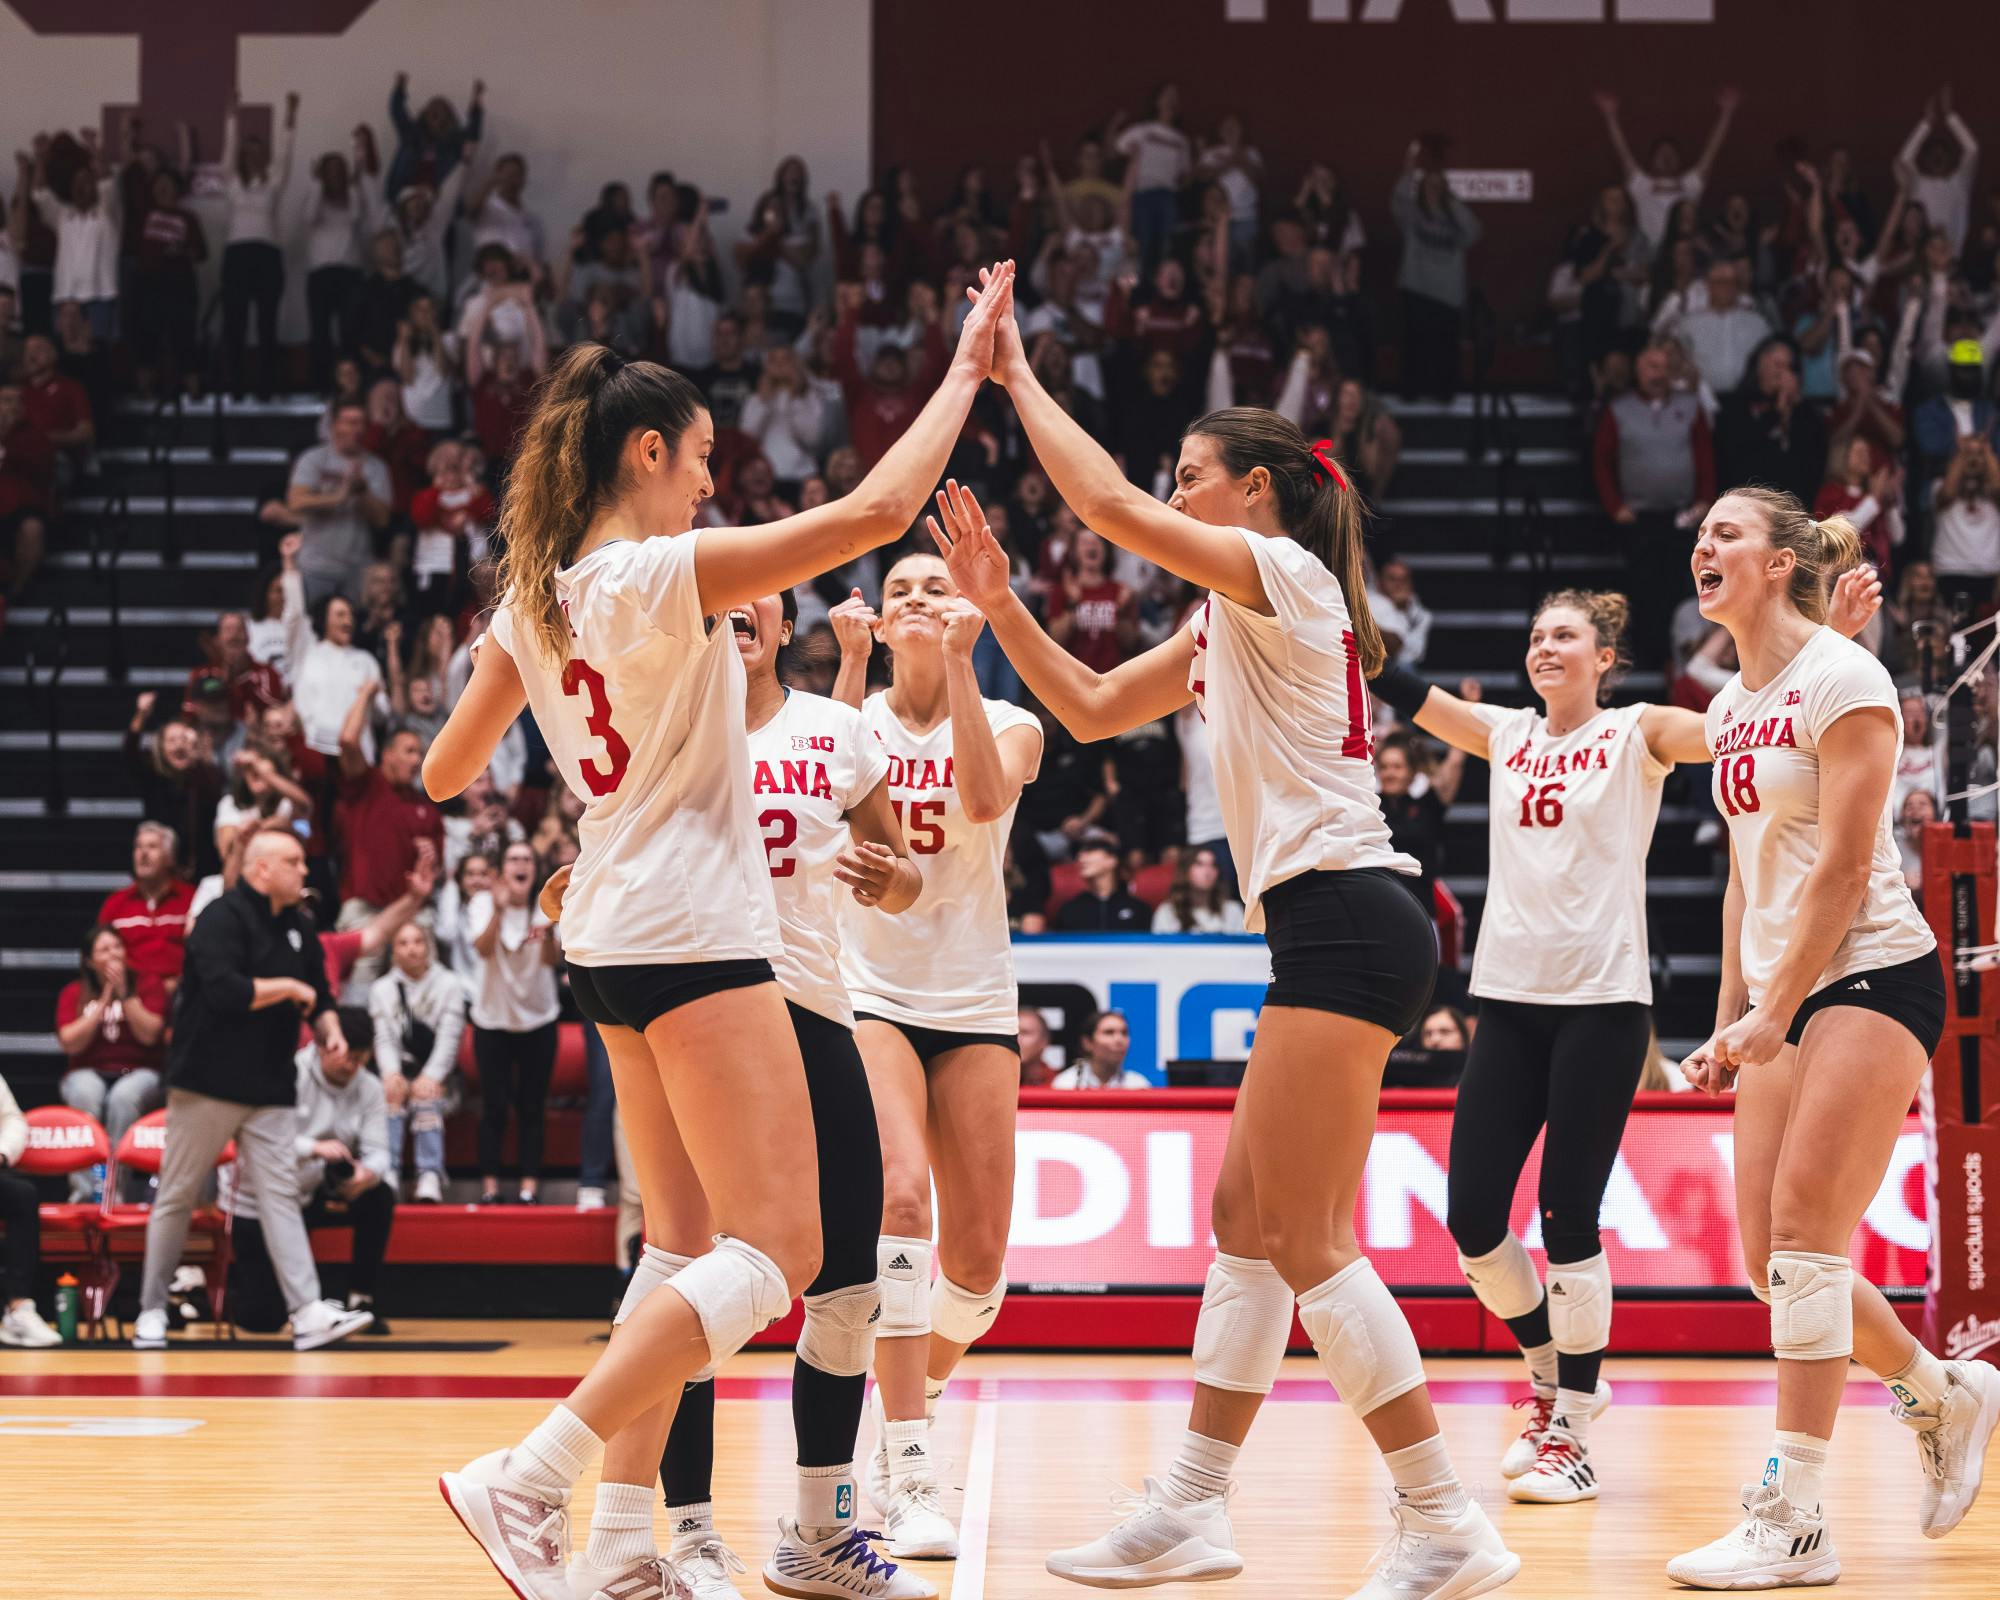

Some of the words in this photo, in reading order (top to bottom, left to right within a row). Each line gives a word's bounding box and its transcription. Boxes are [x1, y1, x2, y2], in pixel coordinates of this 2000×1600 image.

[560, 658, 631, 797] 3
[1341, 628, 1376, 766] 1
[1519, 782, 1566, 828] 16
[1720, 753, 1761, 817] 18
[28, 1125, 95, 1149] DIANA
[1963, 1151, 1985, 1214] sports
[888, 1262, 913, 1270] adidas
[1964, 1214, 1986, 1291] imports
